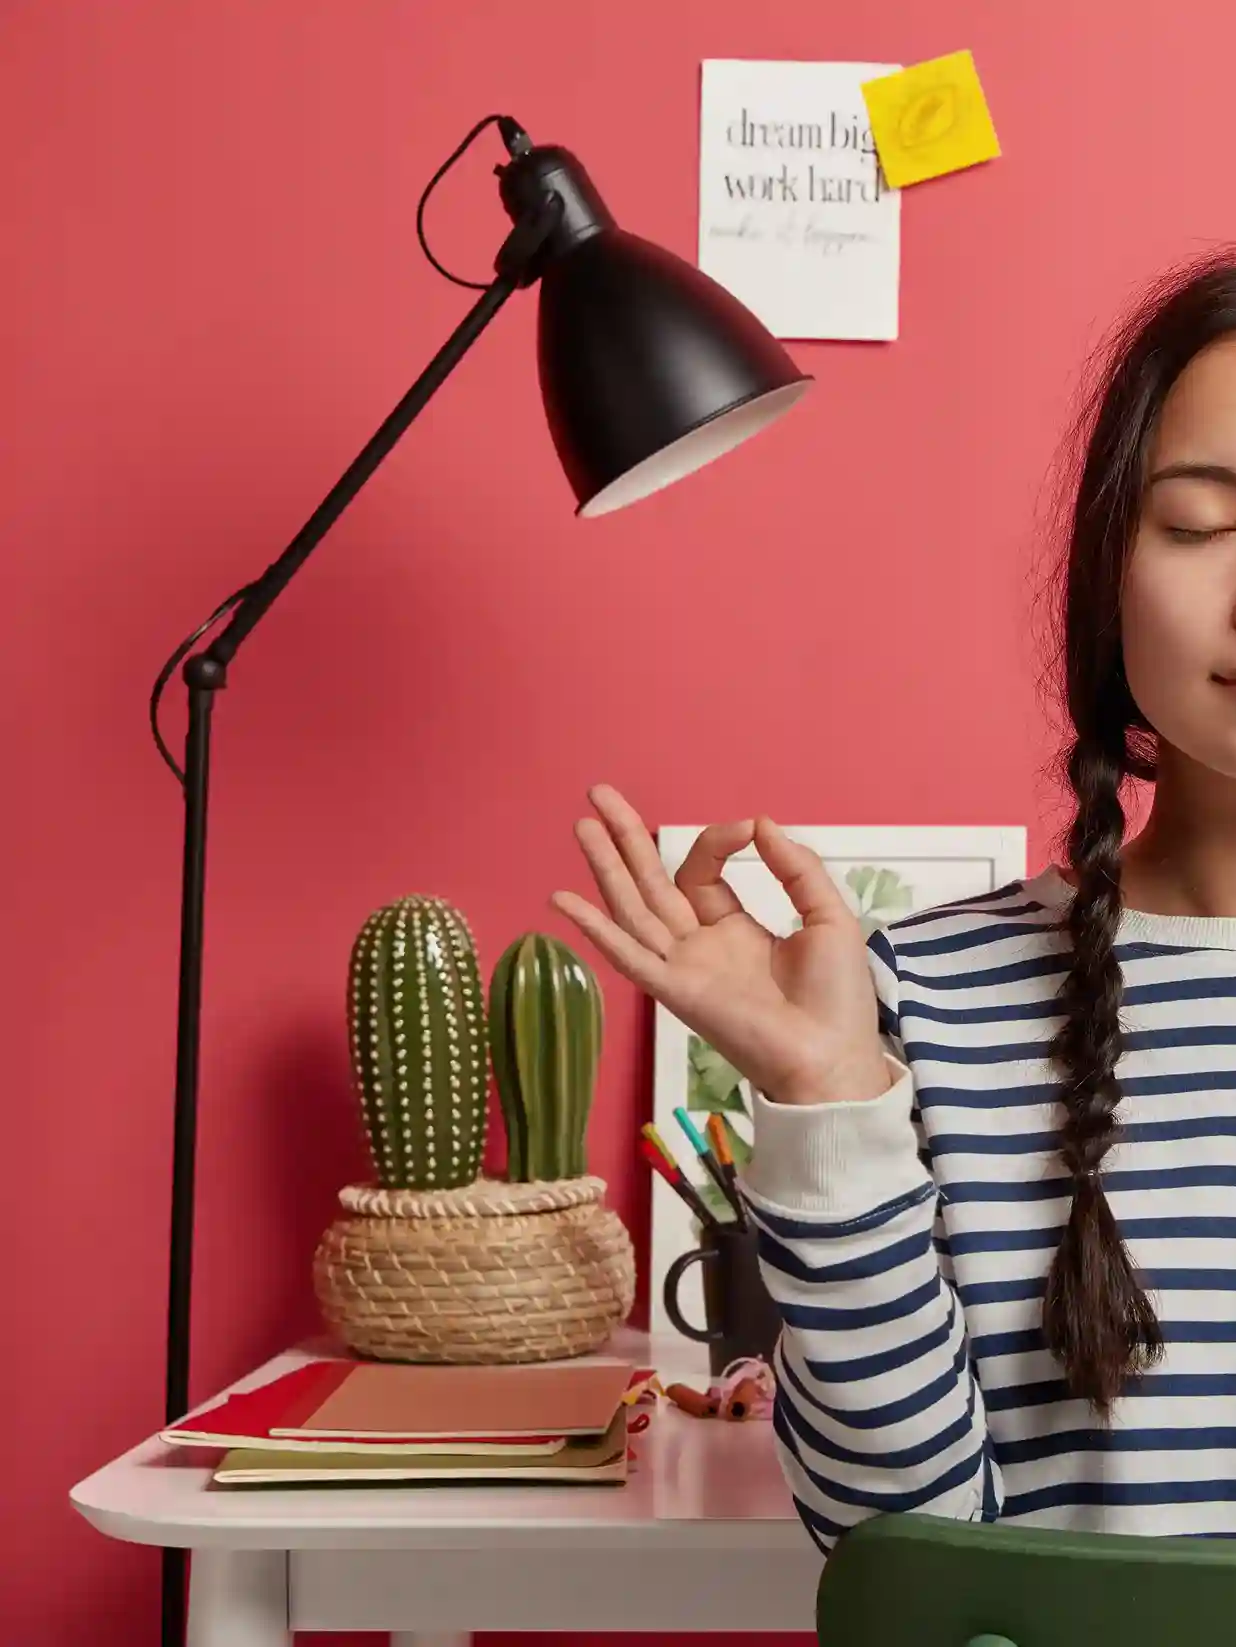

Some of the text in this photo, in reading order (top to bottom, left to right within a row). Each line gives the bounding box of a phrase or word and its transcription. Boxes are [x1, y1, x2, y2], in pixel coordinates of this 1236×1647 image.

[725, 107, 822, 149] dream
[724, 163, 881, 203] work hard
